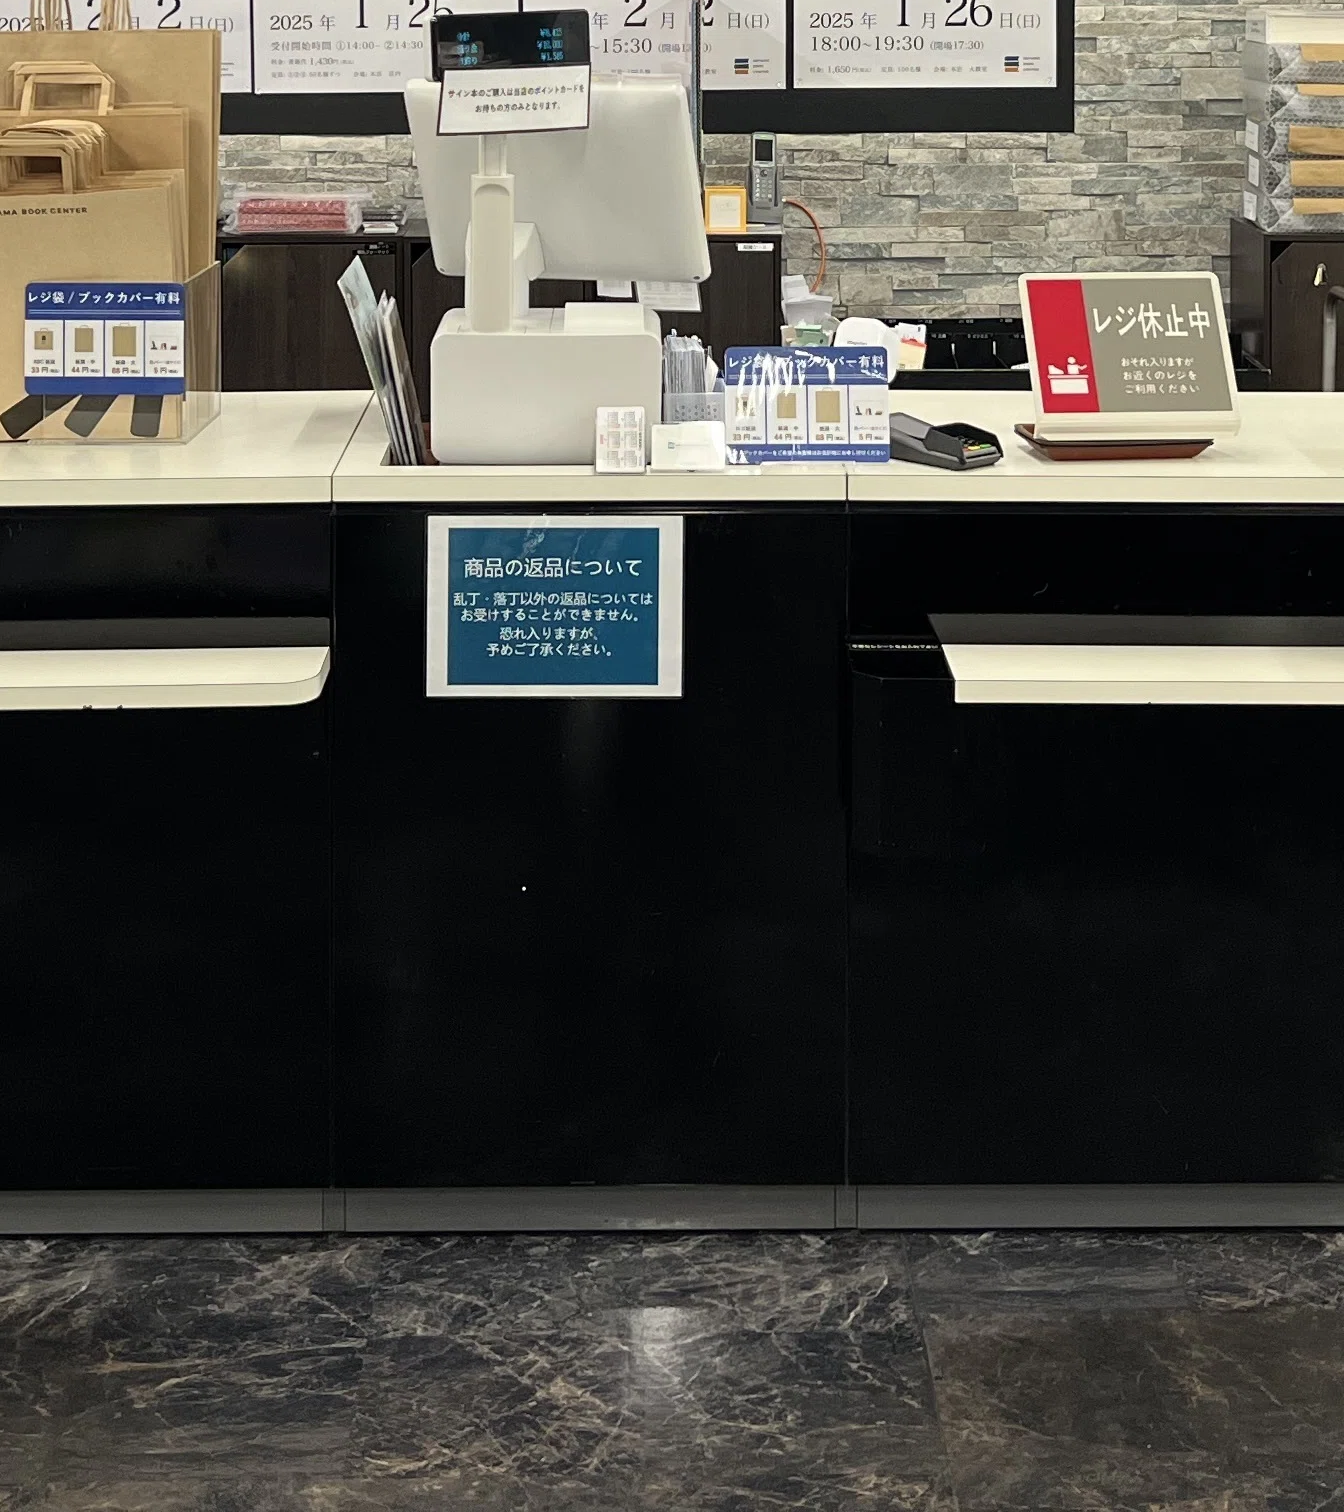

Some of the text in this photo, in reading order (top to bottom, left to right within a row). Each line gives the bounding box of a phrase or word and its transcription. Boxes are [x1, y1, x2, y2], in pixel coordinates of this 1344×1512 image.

[270, 41, 332, 51] 受付開始時間
[475, 102, 561, 113] お持ちの方のみとなります。
[21, 206, 47, 216] BOOK
[50, 205, 88, 214] CENTER
[28, 292, 180, 305] レジ袋 ブックカバー有料
[1092, 302, 1211, 338] レジ休止中
[1121, 357, 1194, 367] おそれ入りますが
[1123, 370, 1197, 381] お近くのレジを
[1125, 384, 1200, 395] ご利用ください
[464, 558, 643, 578] 商品の返品について
[453, 592, 654, 606] 乱丁・落丁以外の返品については
[460, 608, 640, 622] お受けすることができません。
[499, 627, 598, 640] 恐れ入りますが、
[486, 643, 612, 657] 予めご了承ください。
